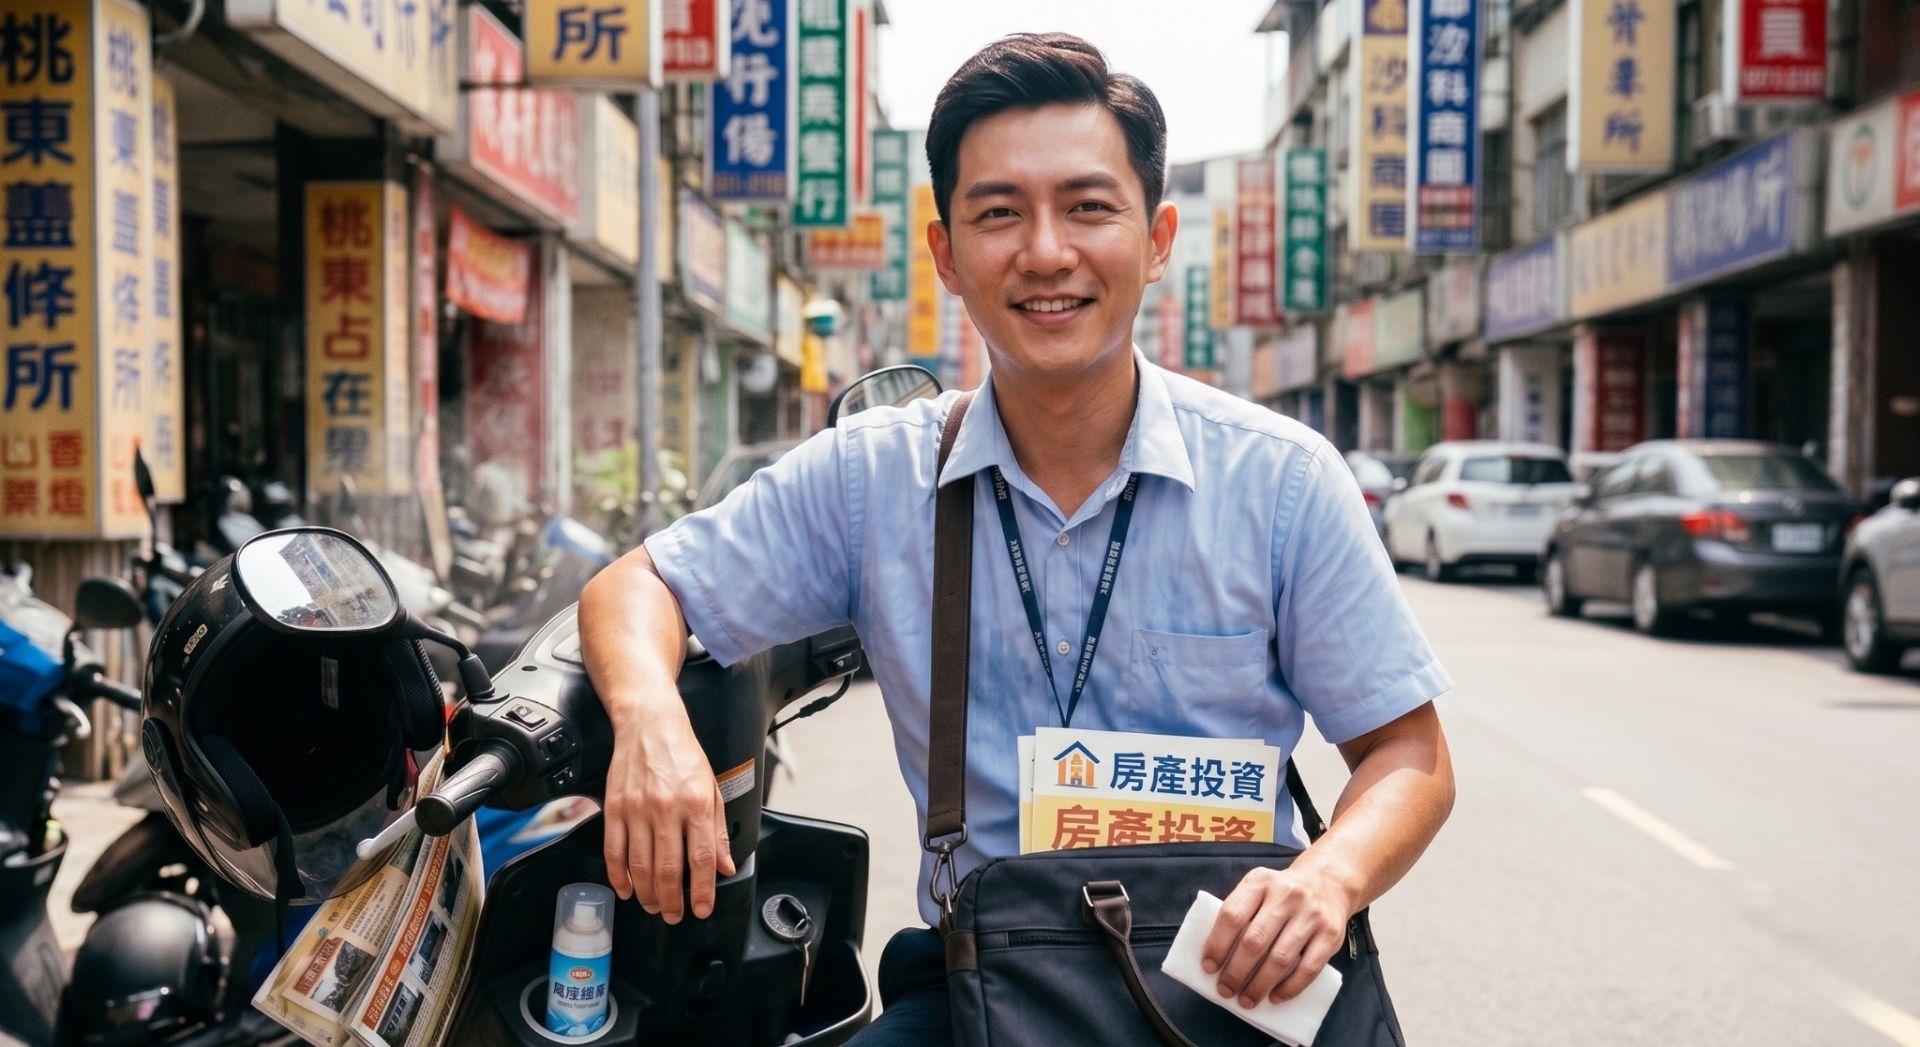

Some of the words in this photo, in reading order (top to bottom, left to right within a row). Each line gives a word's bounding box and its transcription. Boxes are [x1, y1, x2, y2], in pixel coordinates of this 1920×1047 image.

[554, 8, 627, 62] 所
[1110, 752, 1265, 802] 房產投資
